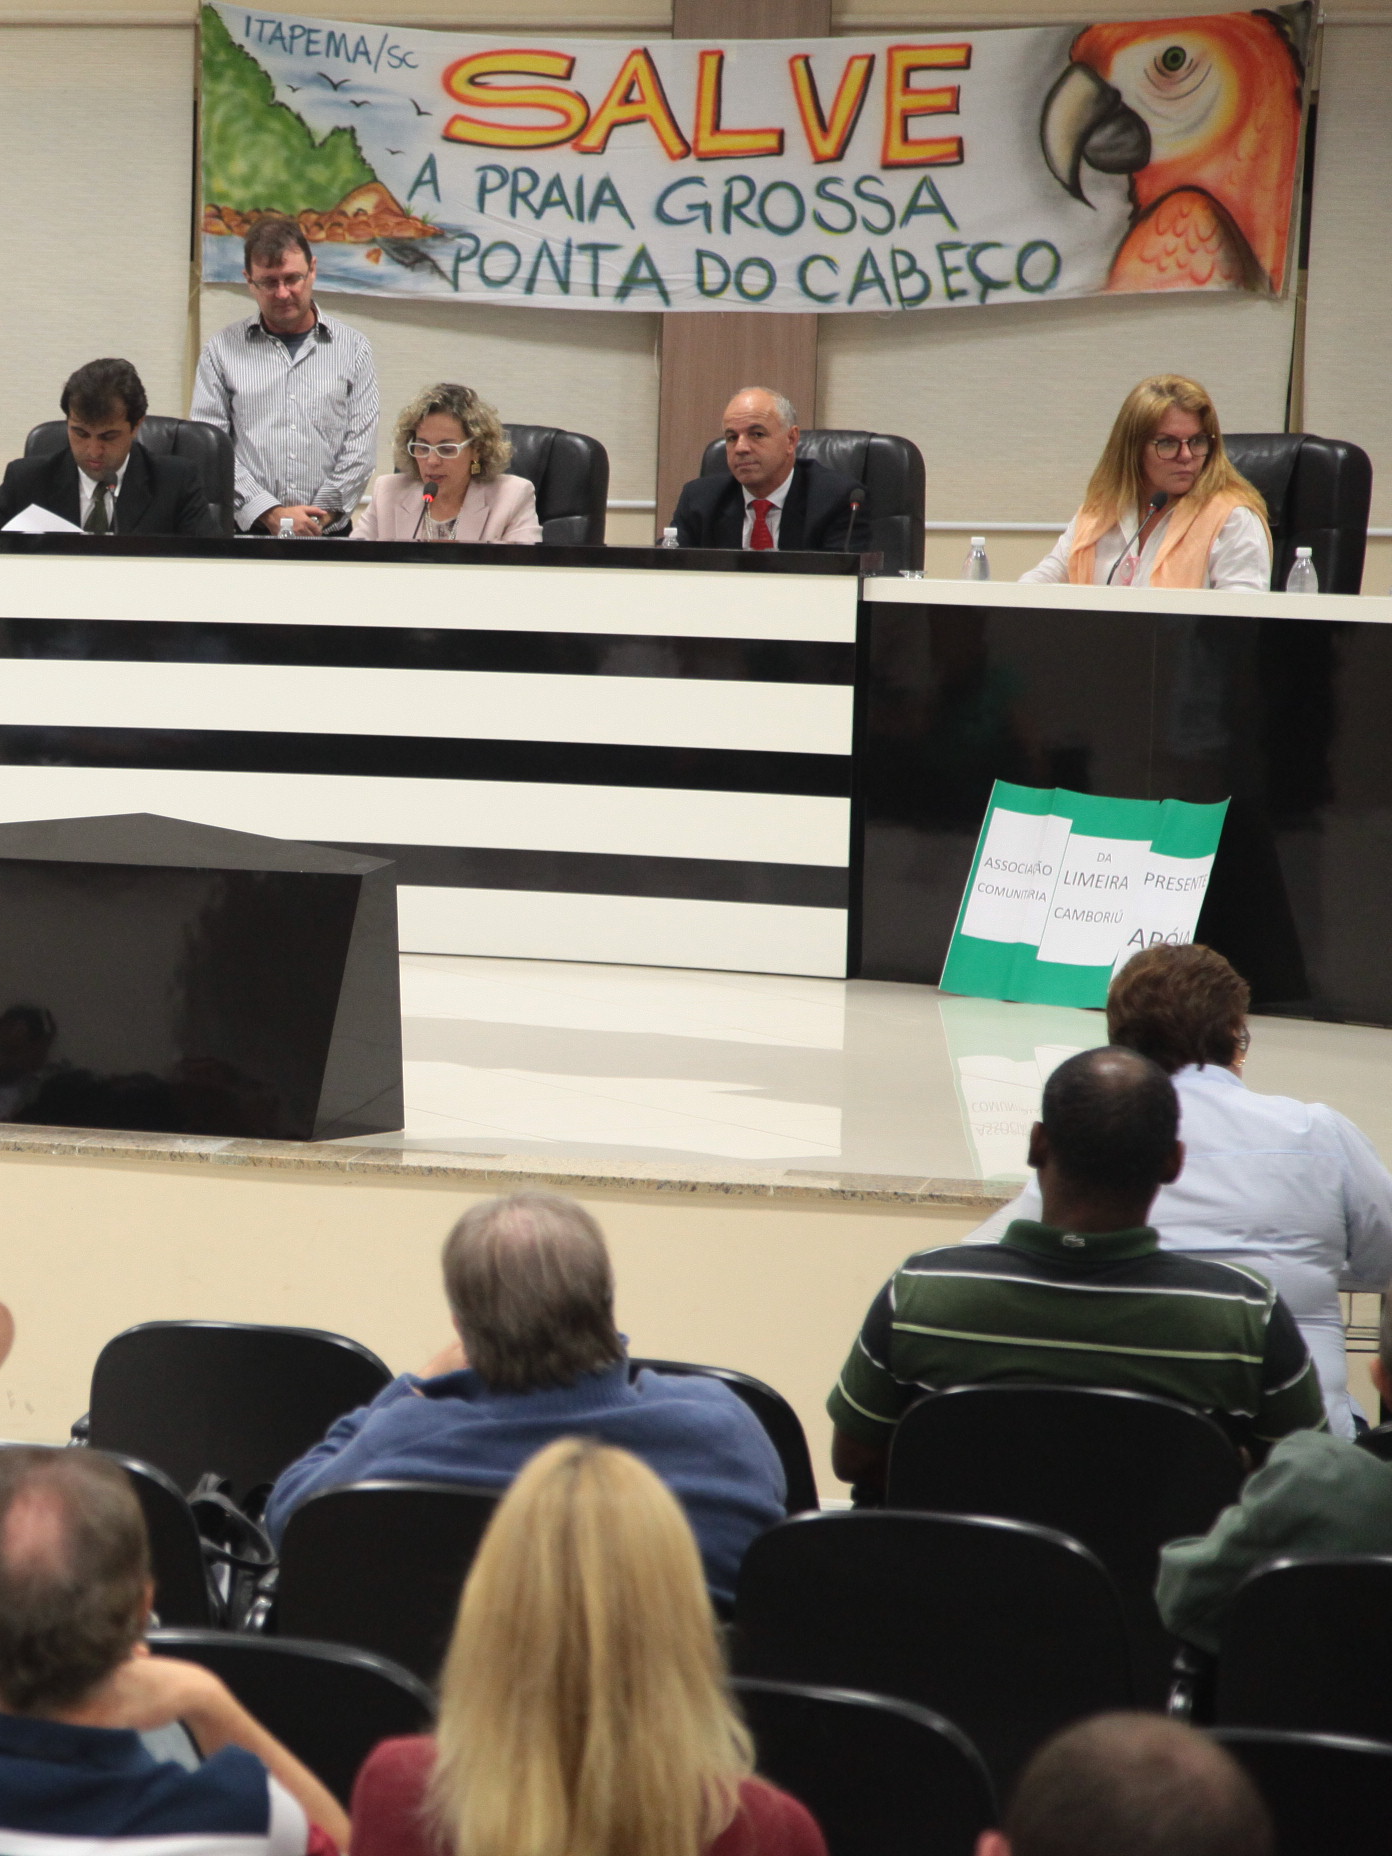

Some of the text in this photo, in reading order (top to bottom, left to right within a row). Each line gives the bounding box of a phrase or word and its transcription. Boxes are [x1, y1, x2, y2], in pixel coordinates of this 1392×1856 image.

[244, 14, 419, 72] ITAPEMA/SC
[441, 43, 972, 169] SALVE
[408, 153, 959, 236] A PRAIA GROSSA
[449, 233, 1063, 310] PONTA DO CABEÇO
[1096, 852, 1112, 864] DA
[1063, 870, 1129, 890] LIMEIRA
[1143, 872, 1207, 892] PRESENTE
[1054, 907, 1124, 924] CAMBORIÚ
